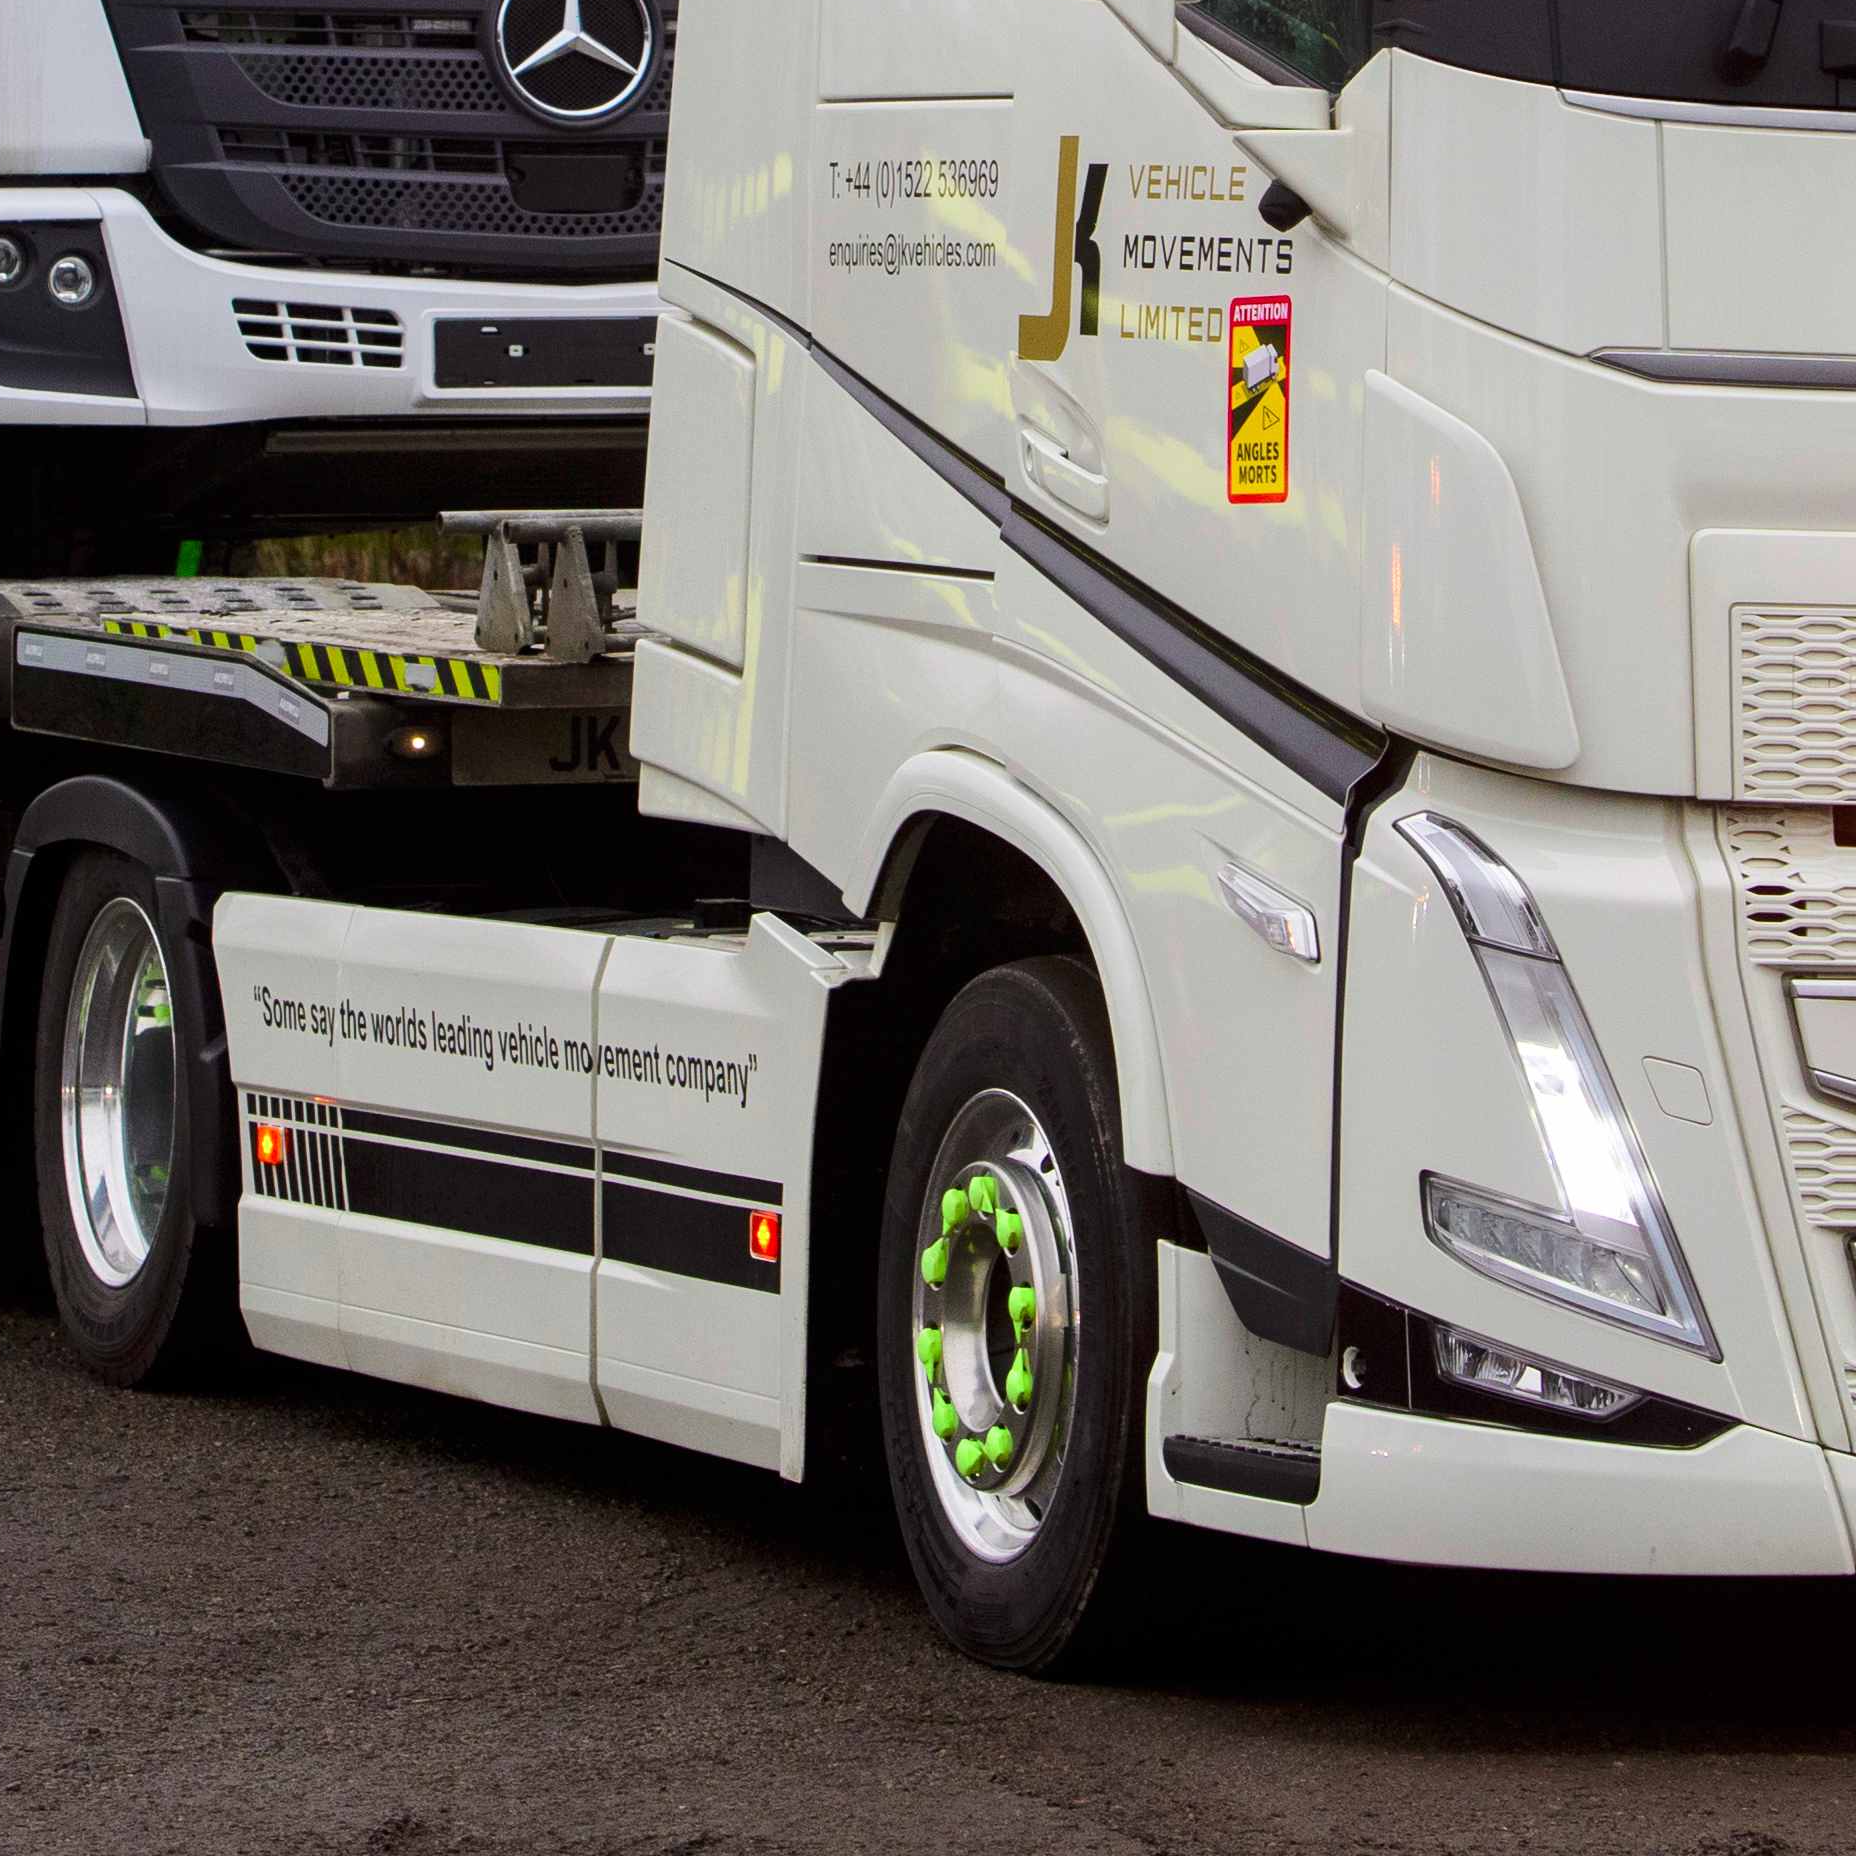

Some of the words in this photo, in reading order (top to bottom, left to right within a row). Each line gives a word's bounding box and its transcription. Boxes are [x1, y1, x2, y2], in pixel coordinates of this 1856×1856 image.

[829, 163, 842, 199] T:
[846, 161, 871, 199] +44
[875, 159, 931, 208] (0)1522
[932, 159, 999, 199] 536969
[1129, 165, 1247, 202] VEHICLE
[829, 232, 997, 276] enquiries@jkvehicles.com
[1123, 234, 1294, 275] MOVEMENTS
[1120, 305, 1224, 343] LIMITED
[1233, 301, 1289, 323] ATTENTION
[1236, 441, 1280, 465] ANGLES
[1238, 465, 1277, 486] MORTS
[549, 715, 622, 772] JK
[310, 1008, 335, 1047] say
[340, 1005, 367, 1041] the
[371, 1007, 427, 1051] worlds
[432, 1013, 494, 1072] leading
[498, 1022, 559, 1070] vehicle
